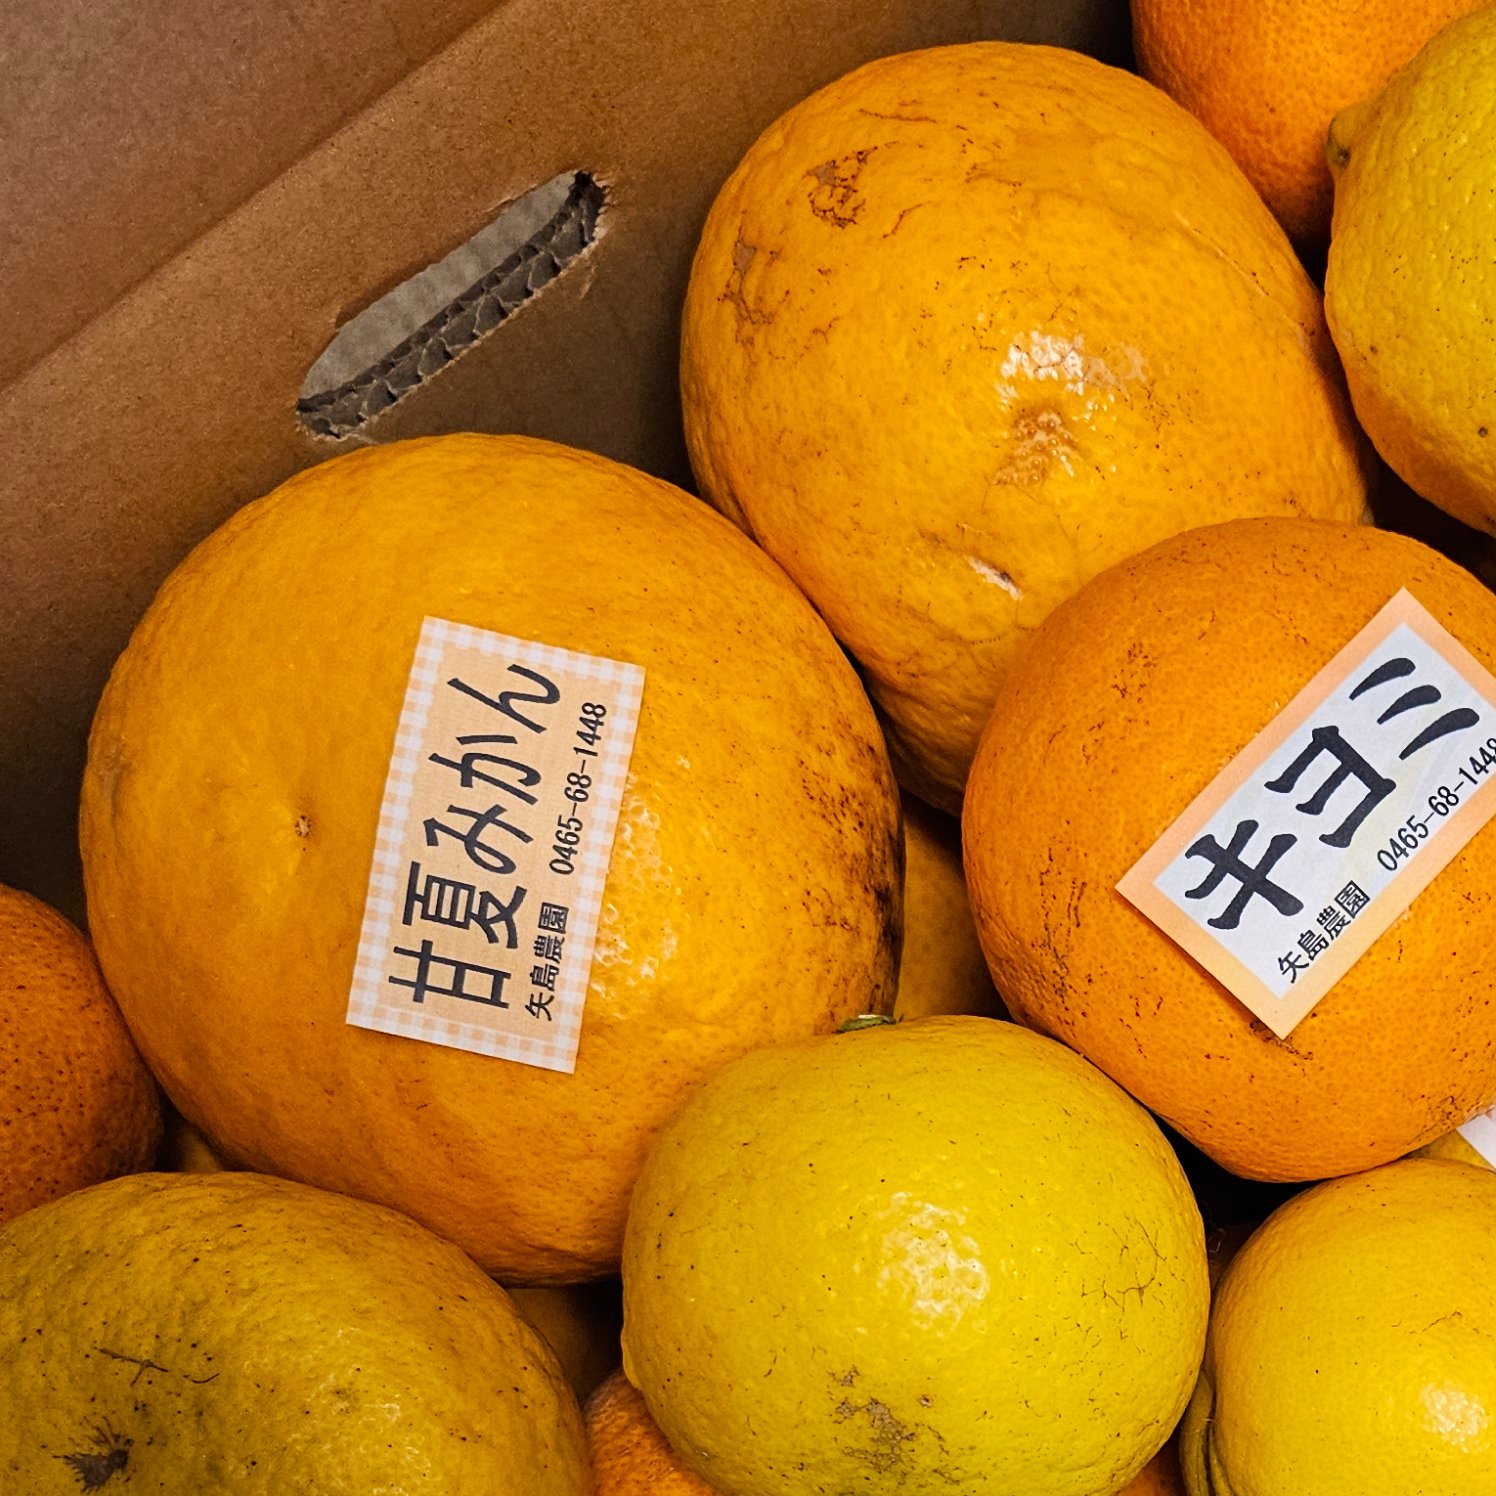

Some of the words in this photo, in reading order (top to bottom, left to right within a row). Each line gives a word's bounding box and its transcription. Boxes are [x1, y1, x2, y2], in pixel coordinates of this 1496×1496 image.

[389, 664, 560, 1008] 甘夏みかん
[525, 902, 569, 1021] 矢島農園
[549, 703, 606, 874] 0465-68-1448
[1185, 658, 1479, 929] キヨミ
[1278, 880, 1370, 983] 矢島農園
